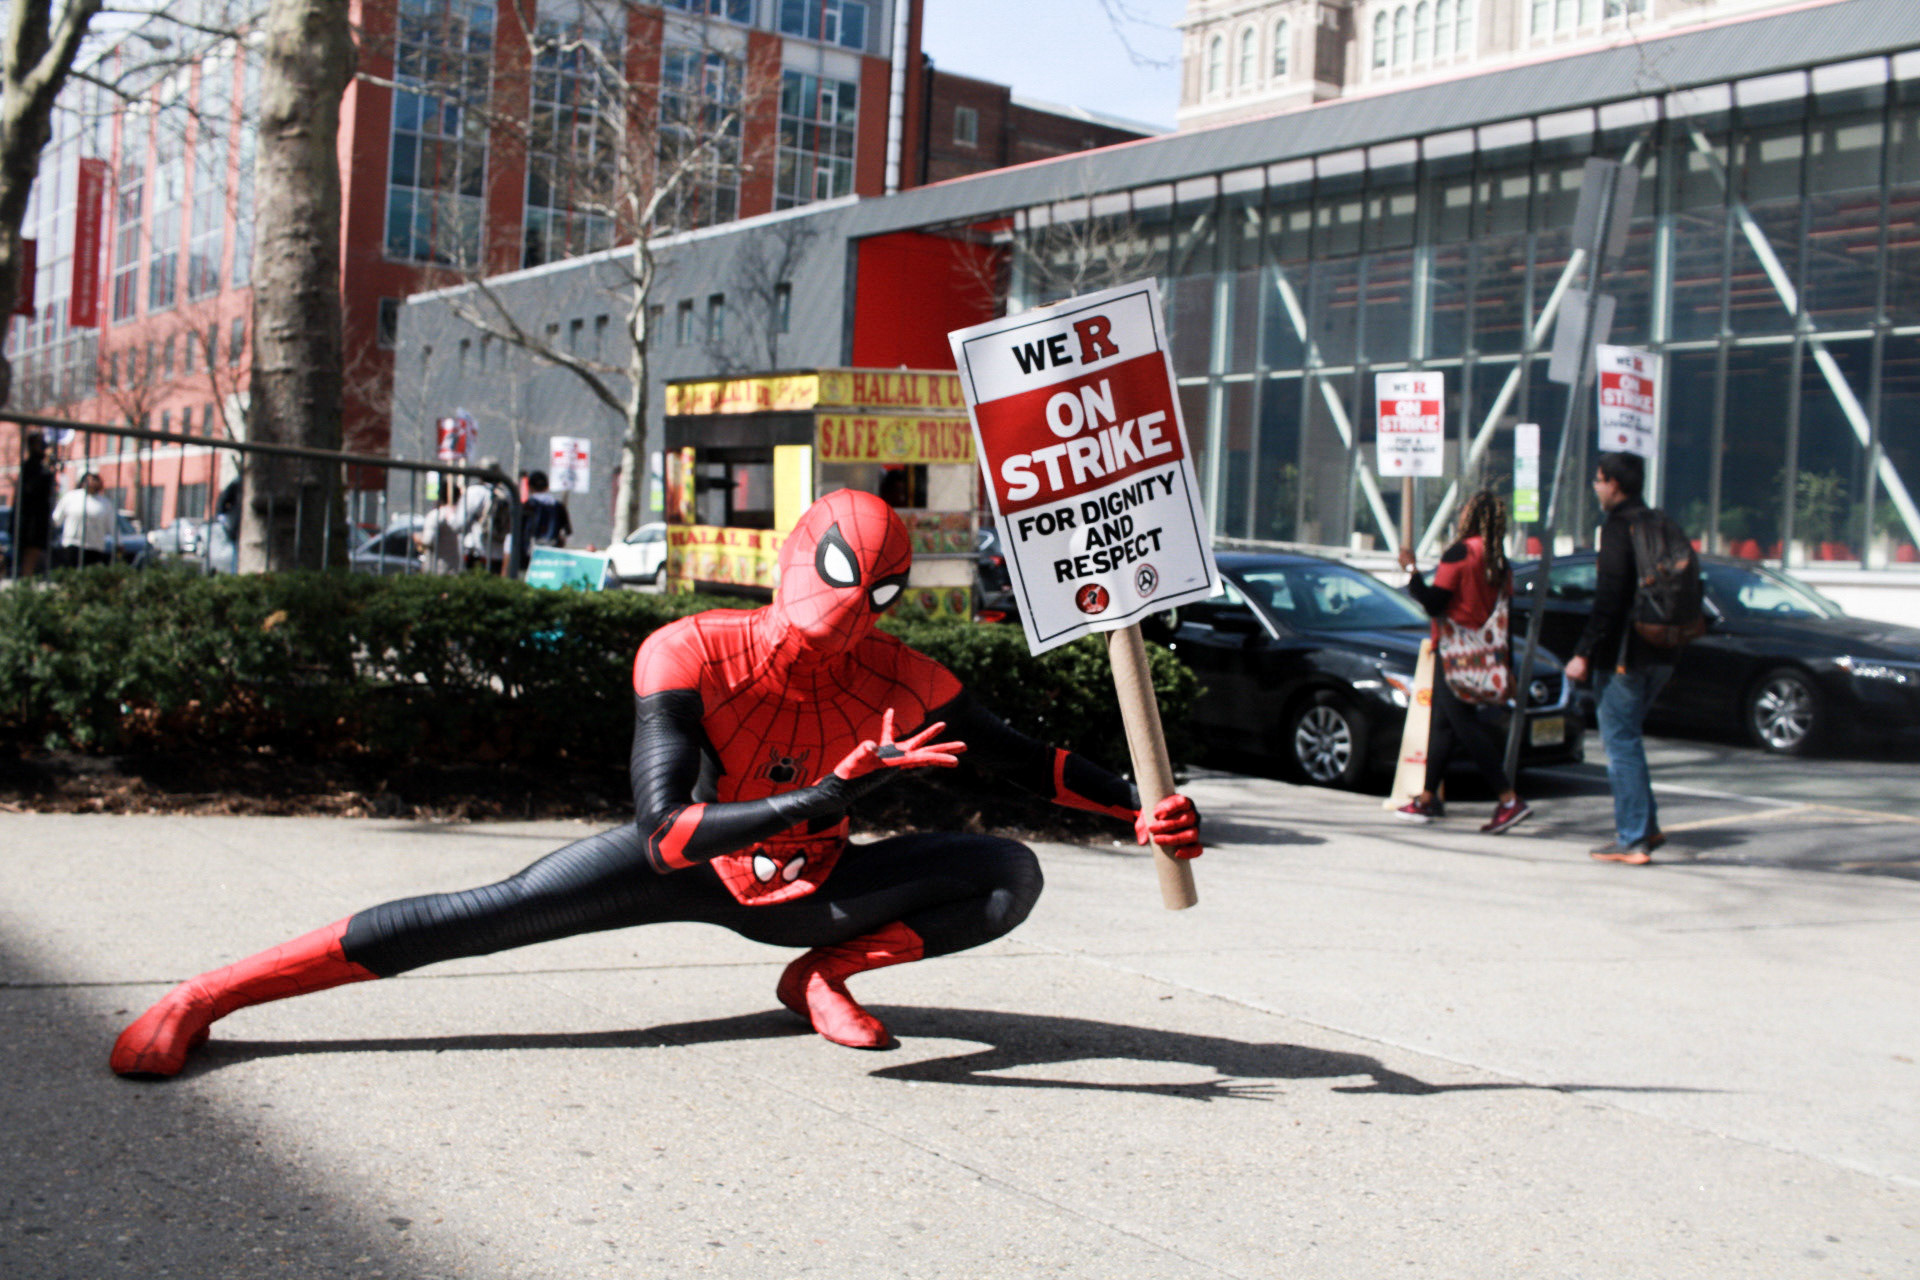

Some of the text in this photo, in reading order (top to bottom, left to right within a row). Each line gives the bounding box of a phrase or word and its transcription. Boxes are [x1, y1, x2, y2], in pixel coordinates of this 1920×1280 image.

[1012, 315, 1119, 374] WE R
[853, 373, 922, 404] HALAL
[928, 375, 941, 405] R
[948, 375, 966, 406] U
[1414, 381, 1426, 393] R
[1602, 388, 1653, 412] STRIKE
[1619, 374, 1640, 392] ON
[1045, 379, 1117, 438] ON
[1381, 415, 1439, 432] STRIKE
[1395, 400, 1421, 415] ON
[822, 418, 972, 458] SAFE TRUST
[1001, 410, 1173, 501] STRIKE
[1018, 471, 1175, 541] FOR DIGNITY
[1085, 514, 1134, 550] AND
[1053, 528, 1163, 583] RESPECT
